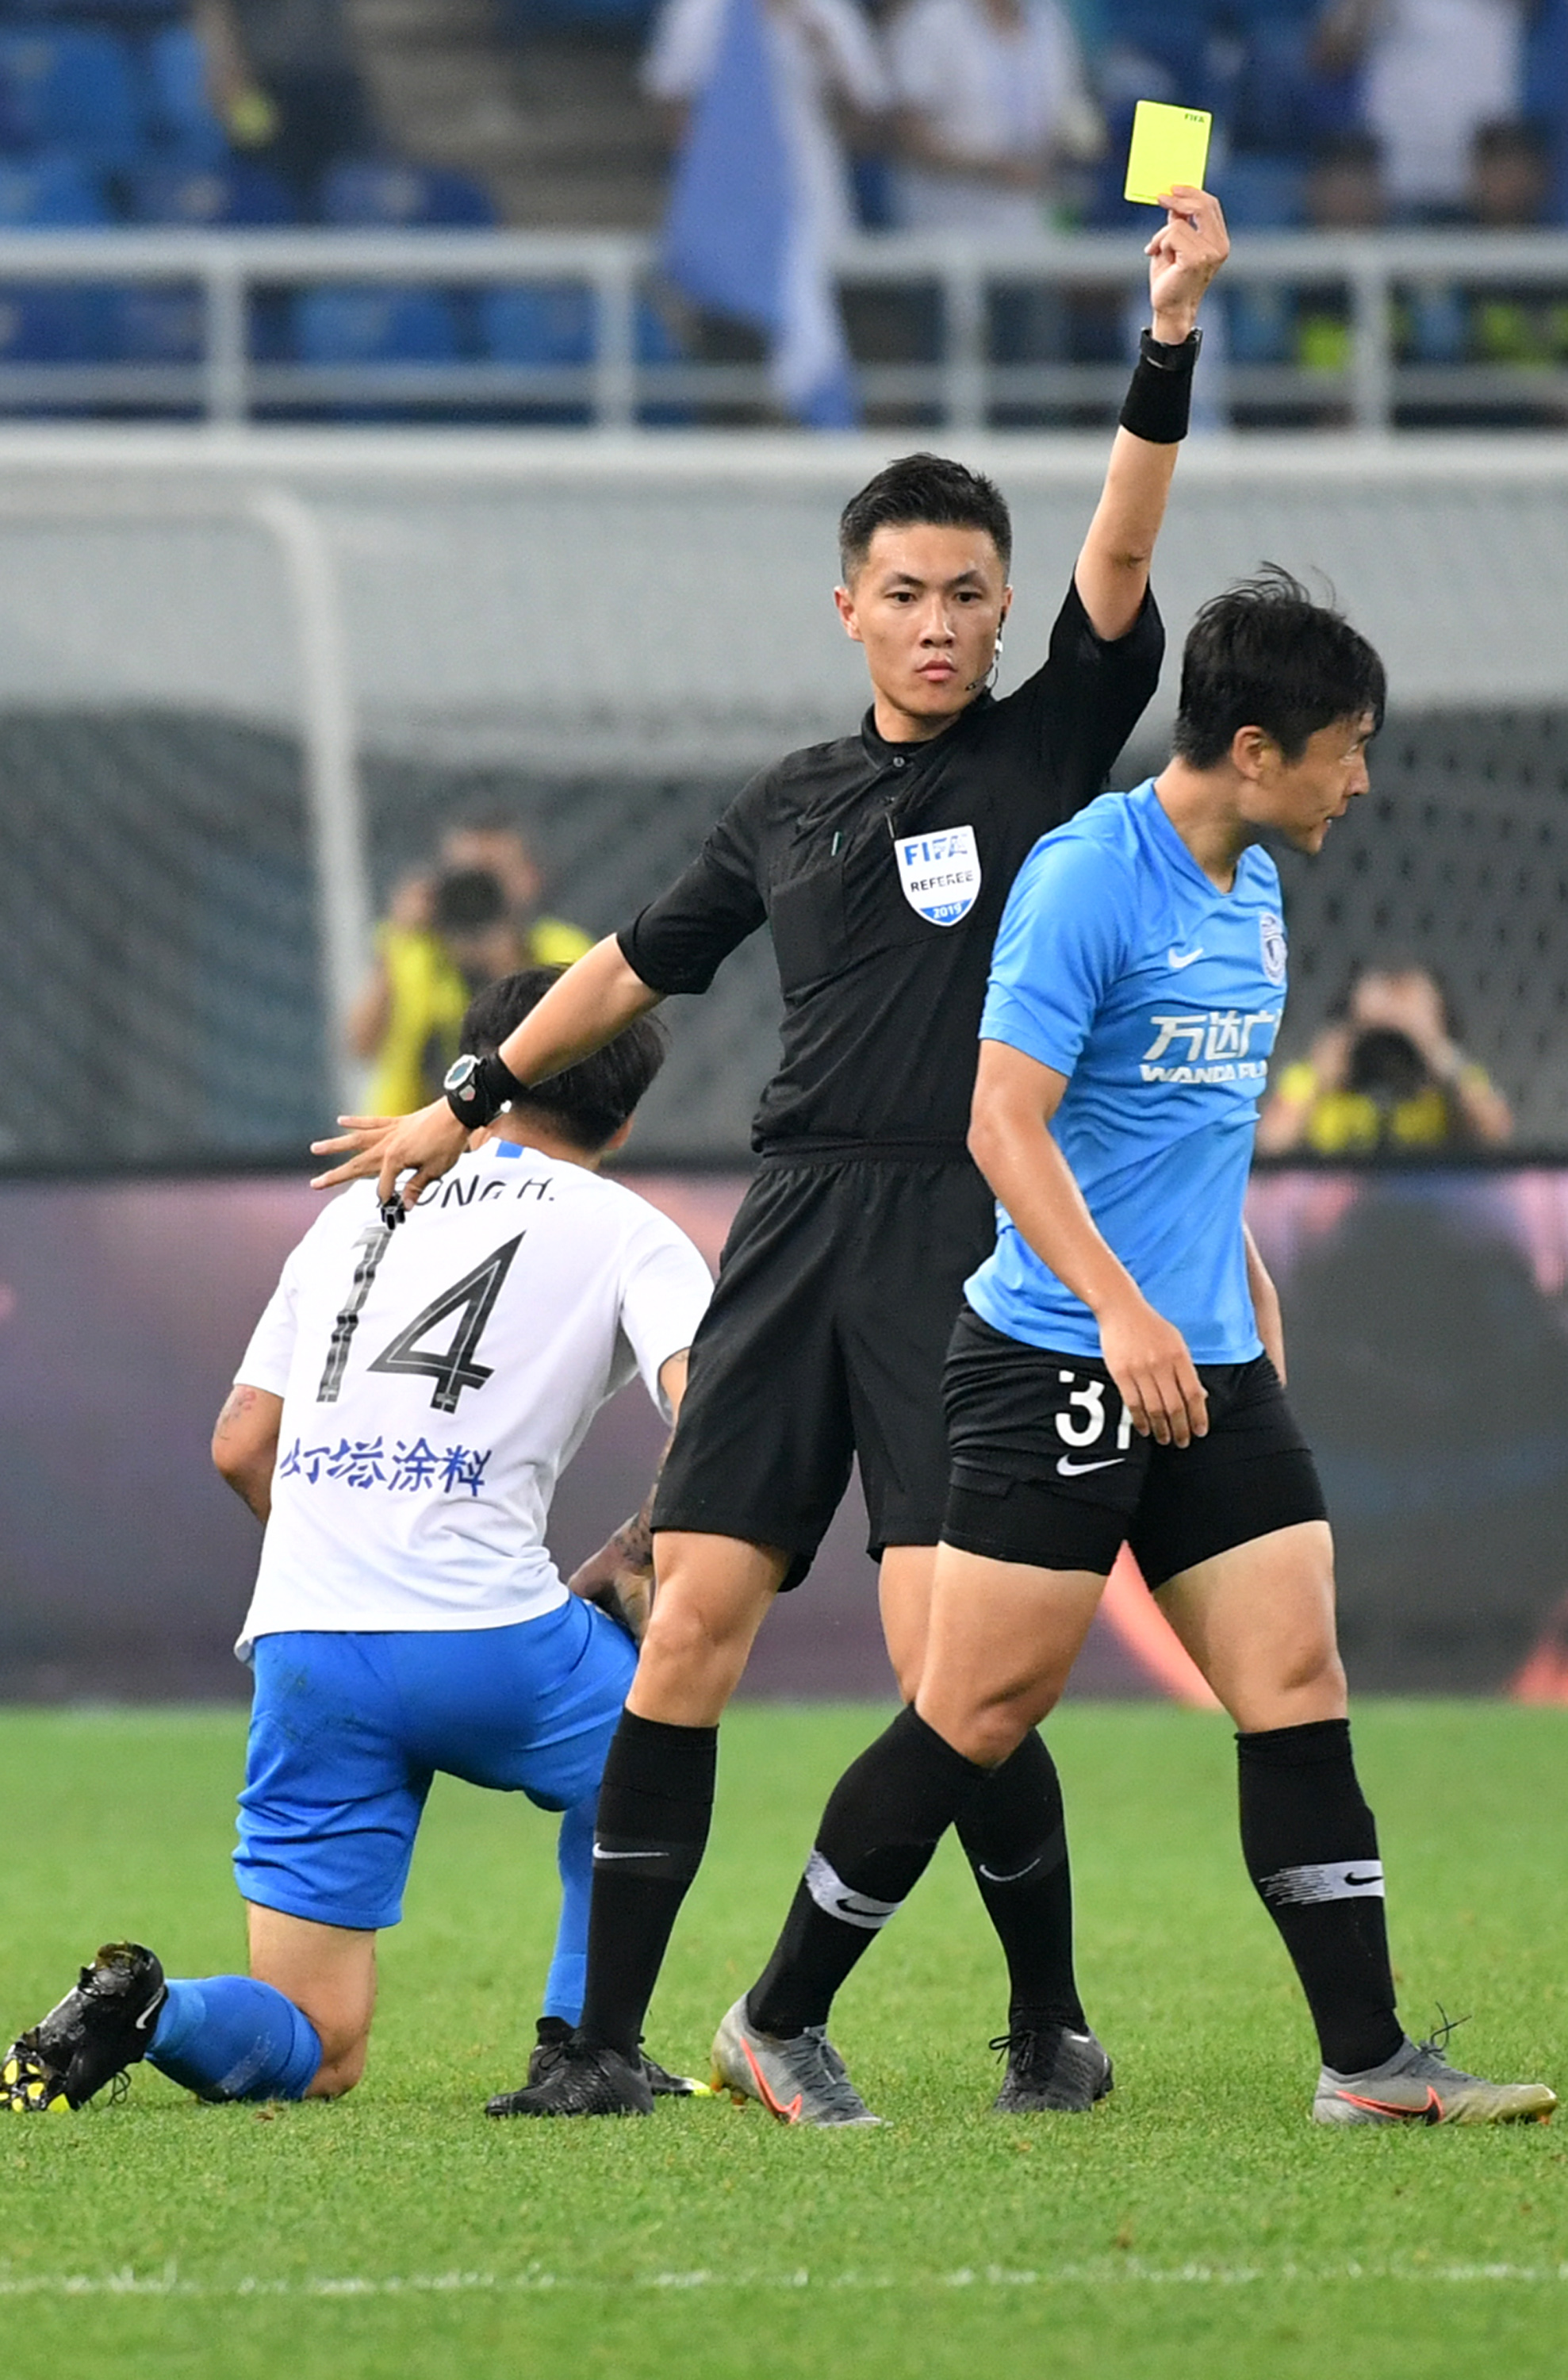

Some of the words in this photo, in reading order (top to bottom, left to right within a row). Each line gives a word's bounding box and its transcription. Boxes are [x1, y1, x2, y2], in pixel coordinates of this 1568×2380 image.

[1183, 113, 1206, 123] FIFA
[903, 833, 968, 866] FIFA
[910, 869, 975, 893] REFEREE
[931, 902, 963, 919] 2019
[1138, 1063, 1236, 1084] WANDA
[376, 1174, 508, 1209] ONG
[315, 1226, 527, 1415] 14
[278, 1436, 493, 1498] 灯塔涂料
